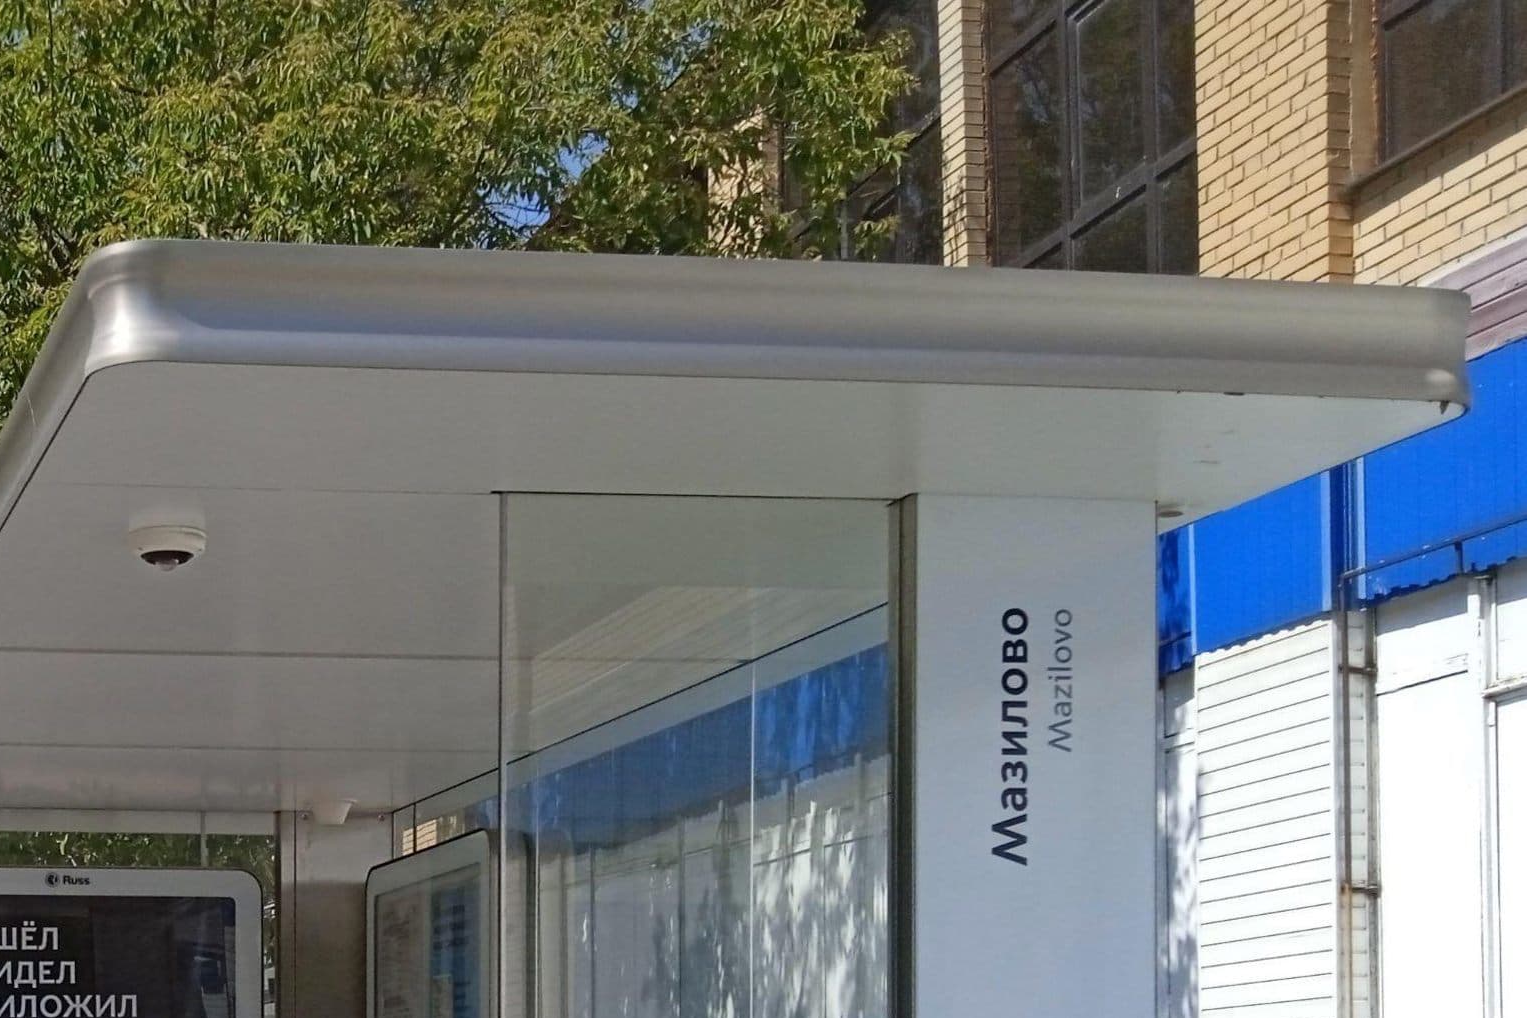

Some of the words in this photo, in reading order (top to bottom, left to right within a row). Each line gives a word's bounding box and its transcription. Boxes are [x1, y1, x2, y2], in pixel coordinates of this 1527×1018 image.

[991, 607, 1029, 866] Мазилово
[1047, 608, 1073, 752] Mazilovo
[62, 875, 90, 885] Russ
